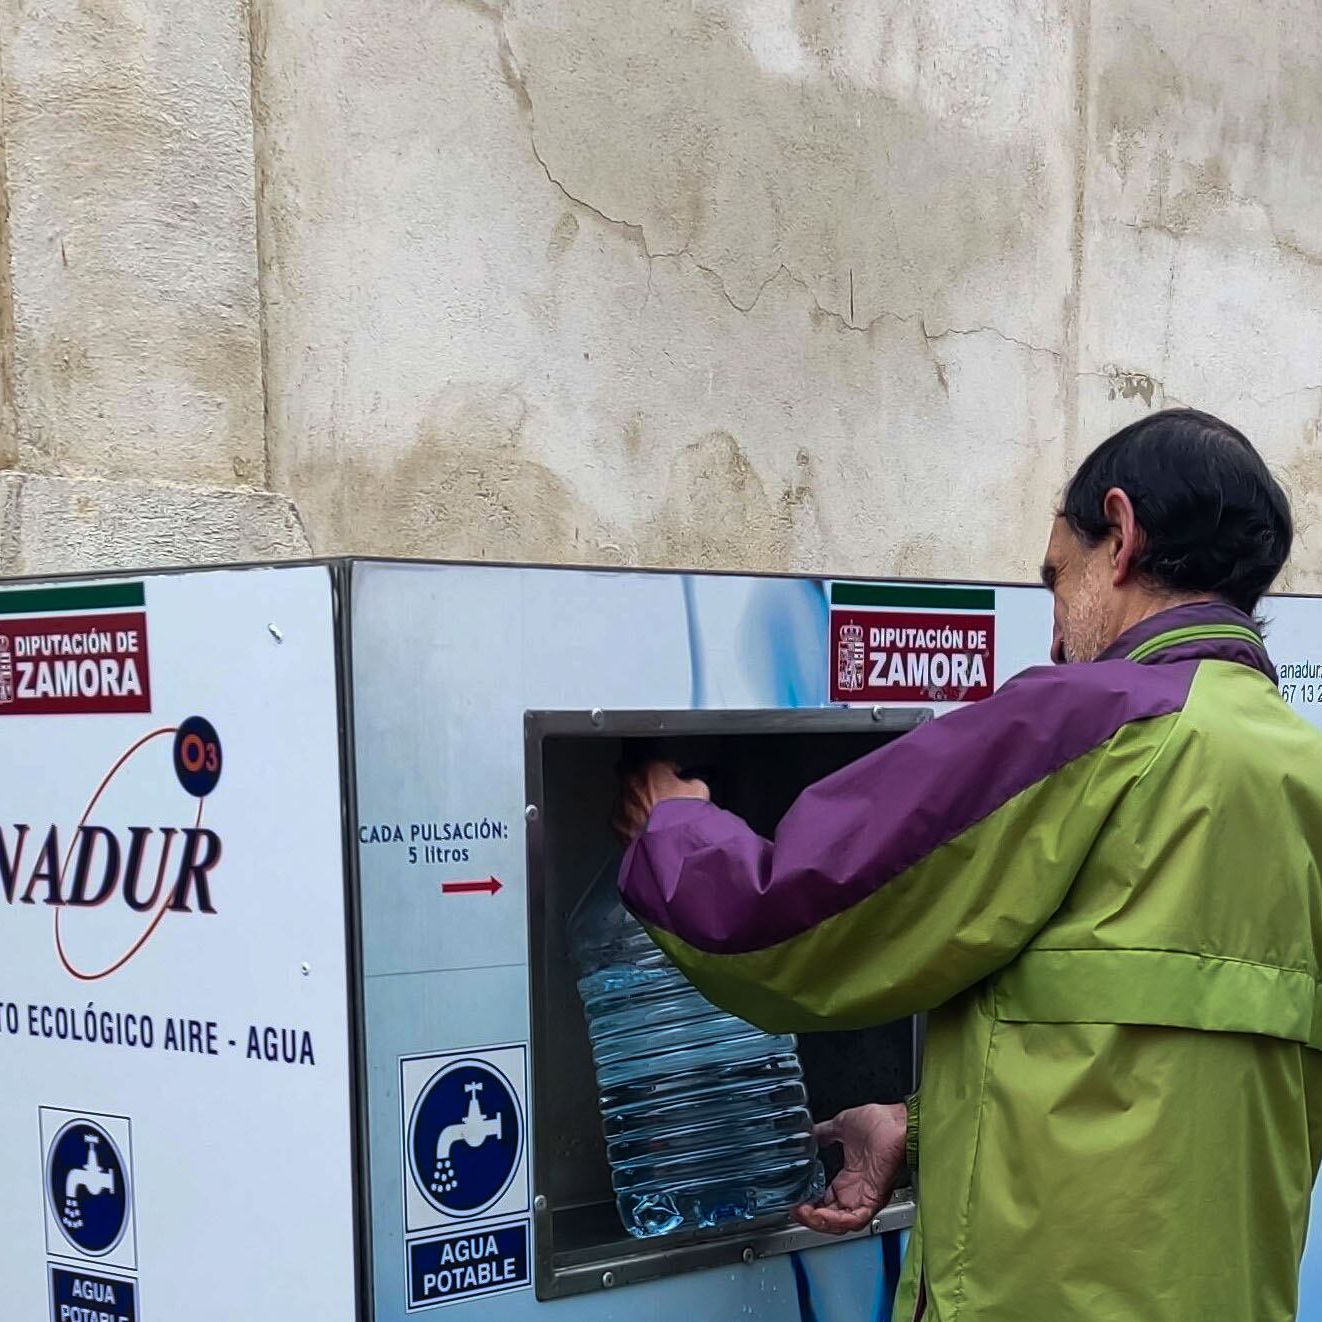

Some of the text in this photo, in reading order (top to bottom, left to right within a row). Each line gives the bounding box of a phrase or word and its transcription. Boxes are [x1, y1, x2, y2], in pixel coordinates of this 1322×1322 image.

[15, 628, 139, 656] DIPUTACIÓN DE
[869, 625, 987, 650] DIPUTACIÓN DE
[15, 657, 142, 699] ZAMORA
[868, 652, 987, 687] ZAMORA
[1301, 684, 1314, 703] 13
[359, 818, 508, 844] CADA PULSACIÓN:
[408, 845, 469, 864] 5 litros
[28, 1001, 153, 1049] ECOLÓGICO
[164, 1018, 218, 1056] AIRE
[246, 1026, 316, 1066] AGUA
[440, 1235, 499, 1265] AGUA
[423, 1257, 516, 1296] POTABLE
[72, 1279, 115, 1305] AGUA
